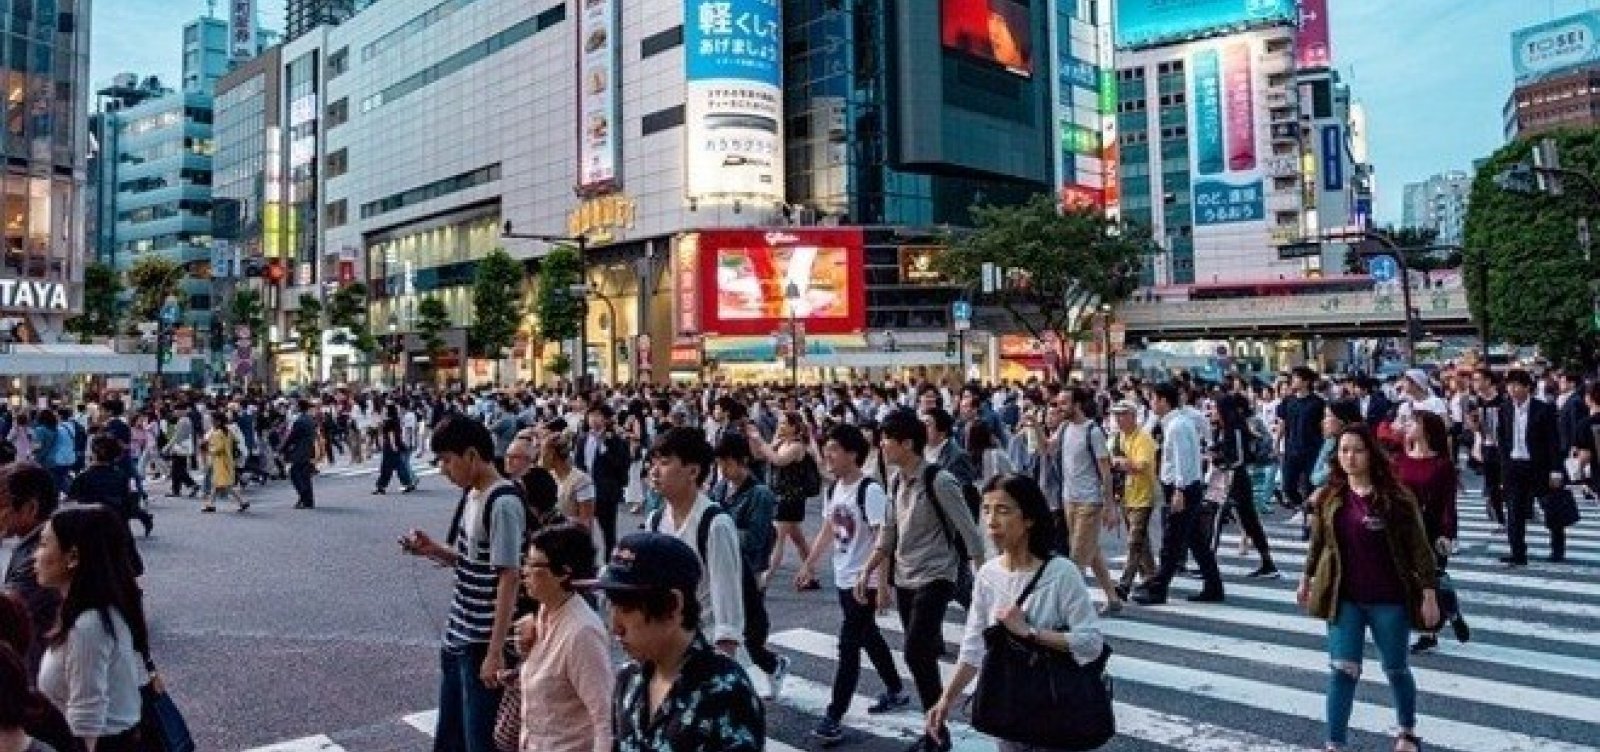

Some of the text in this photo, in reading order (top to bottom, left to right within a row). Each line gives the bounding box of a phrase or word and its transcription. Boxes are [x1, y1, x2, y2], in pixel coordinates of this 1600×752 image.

[698, 2, 777, 40] 軽くして
[699, 38, 777, 61] あげましょう
[0, 279, 68, 309] TAYA
